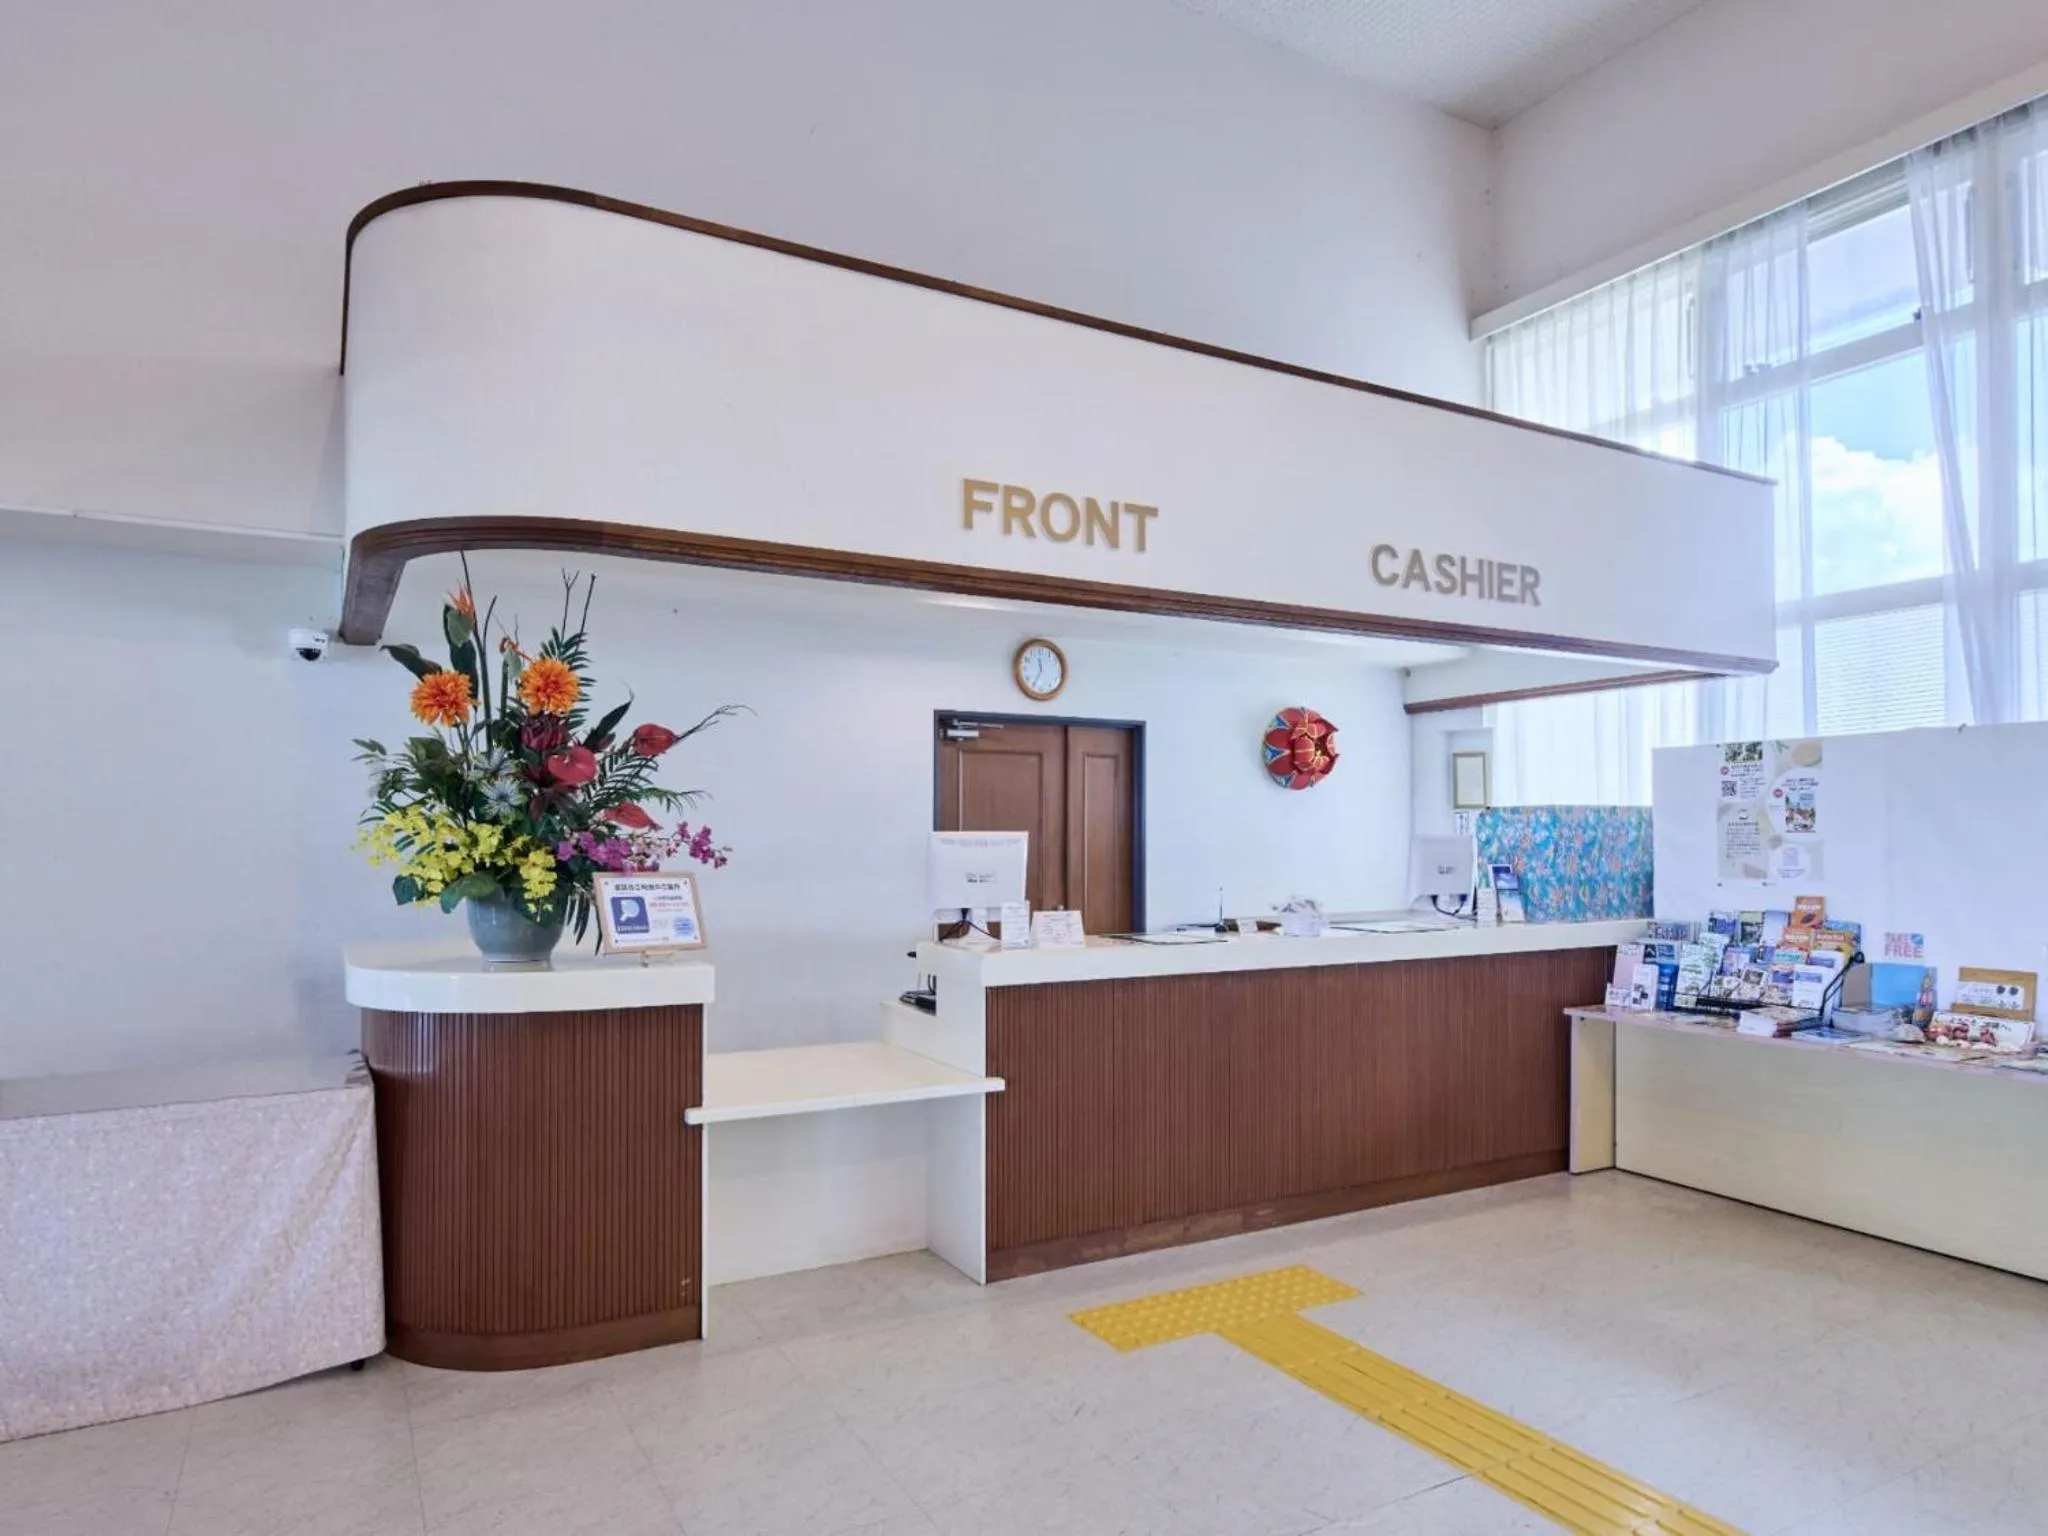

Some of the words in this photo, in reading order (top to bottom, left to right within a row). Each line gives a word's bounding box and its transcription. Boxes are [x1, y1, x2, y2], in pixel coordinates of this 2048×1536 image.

[962, 478, 1159, 552] FRONT
[1371, 543, 1542, 607] CASHIER
[1884, 943, 1924, 958] FREE
